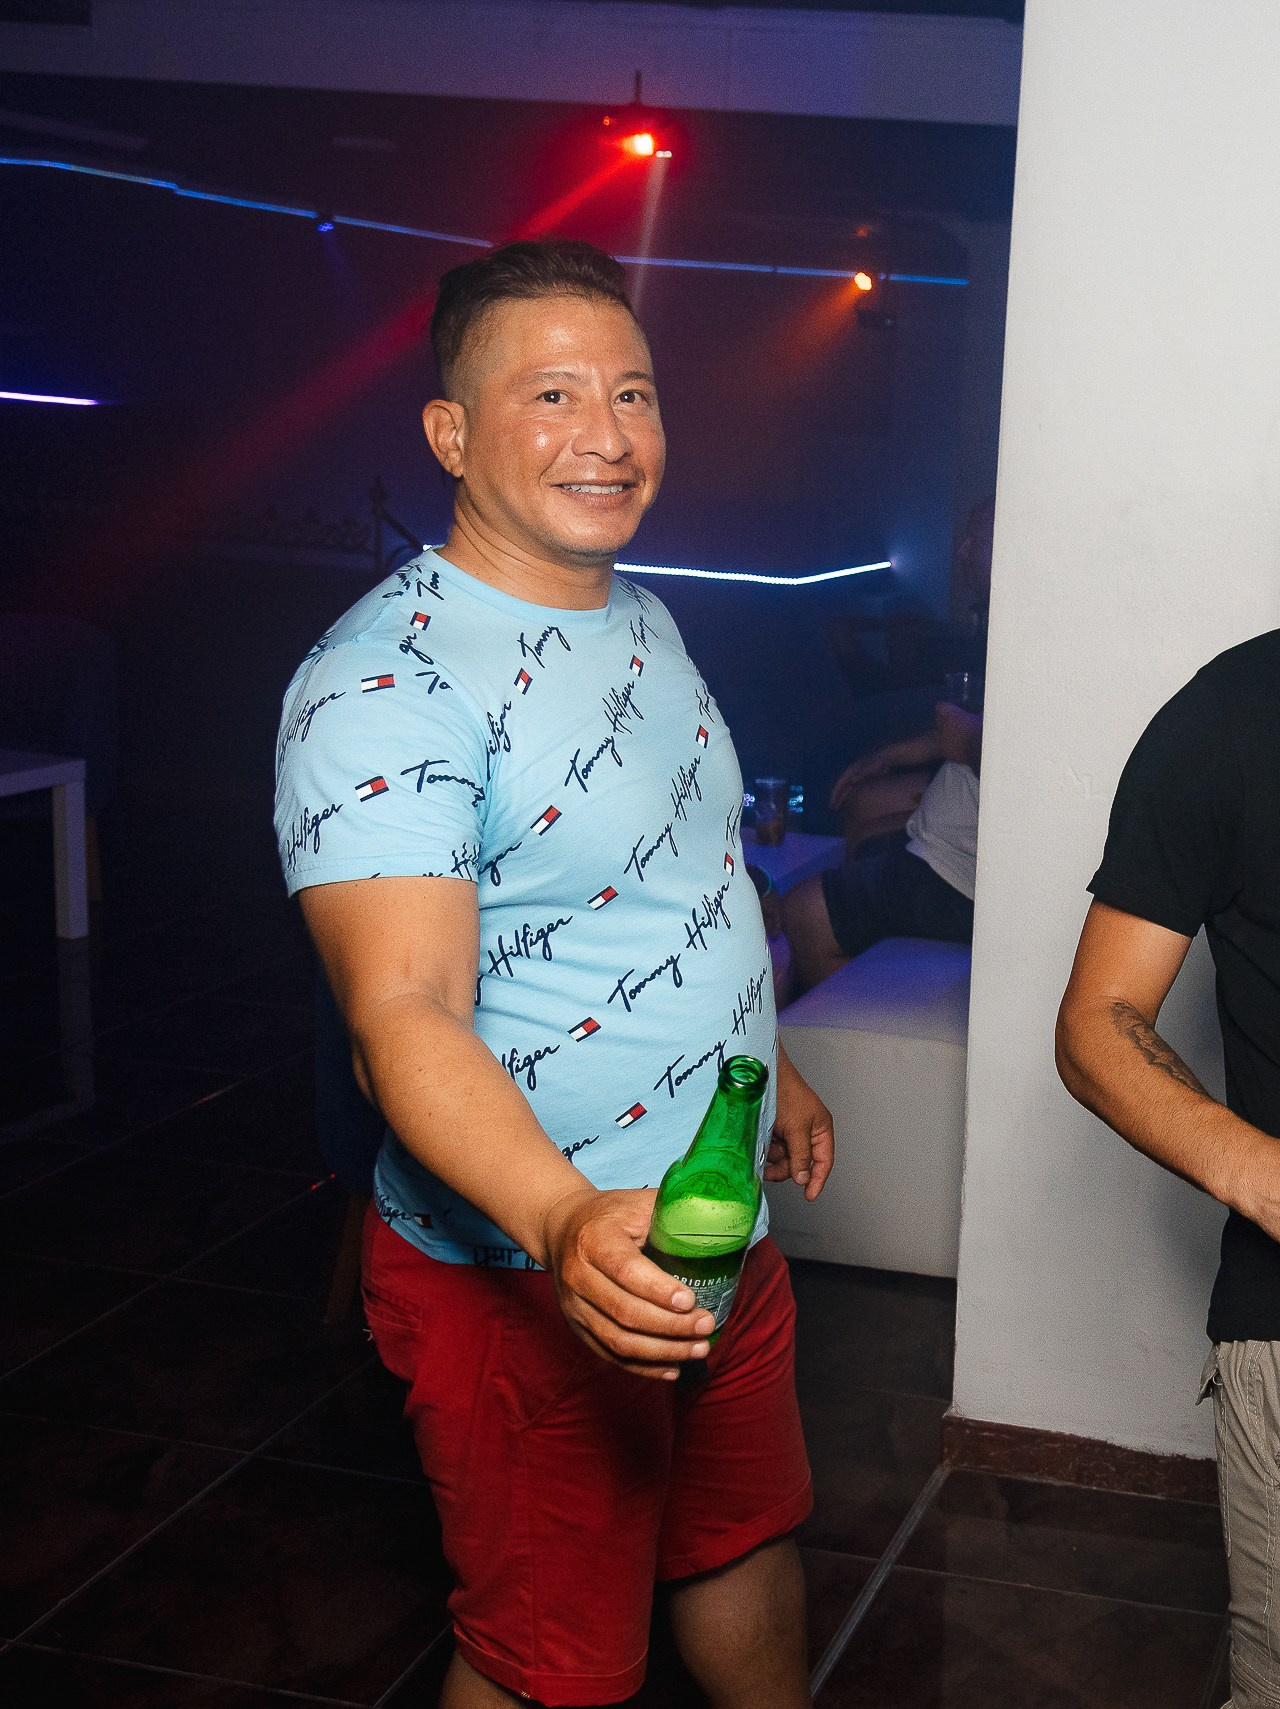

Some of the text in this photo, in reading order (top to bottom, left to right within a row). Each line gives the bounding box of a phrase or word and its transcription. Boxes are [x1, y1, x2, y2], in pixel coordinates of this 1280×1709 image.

[517, 625, 572, 668] Tommy
[565, 681, 645, 793] Tommy Hilfiger
[624, 756, 702, 882] Tommy Hilfiger
[488, 915, 574, 978] Hilfiger
[607, 881, 732, 1013] Tommy Hilfiger
[501, 1045, 561, 1091] lfiger
[653, 966, 768, 1099] Tommy Hilfiger
